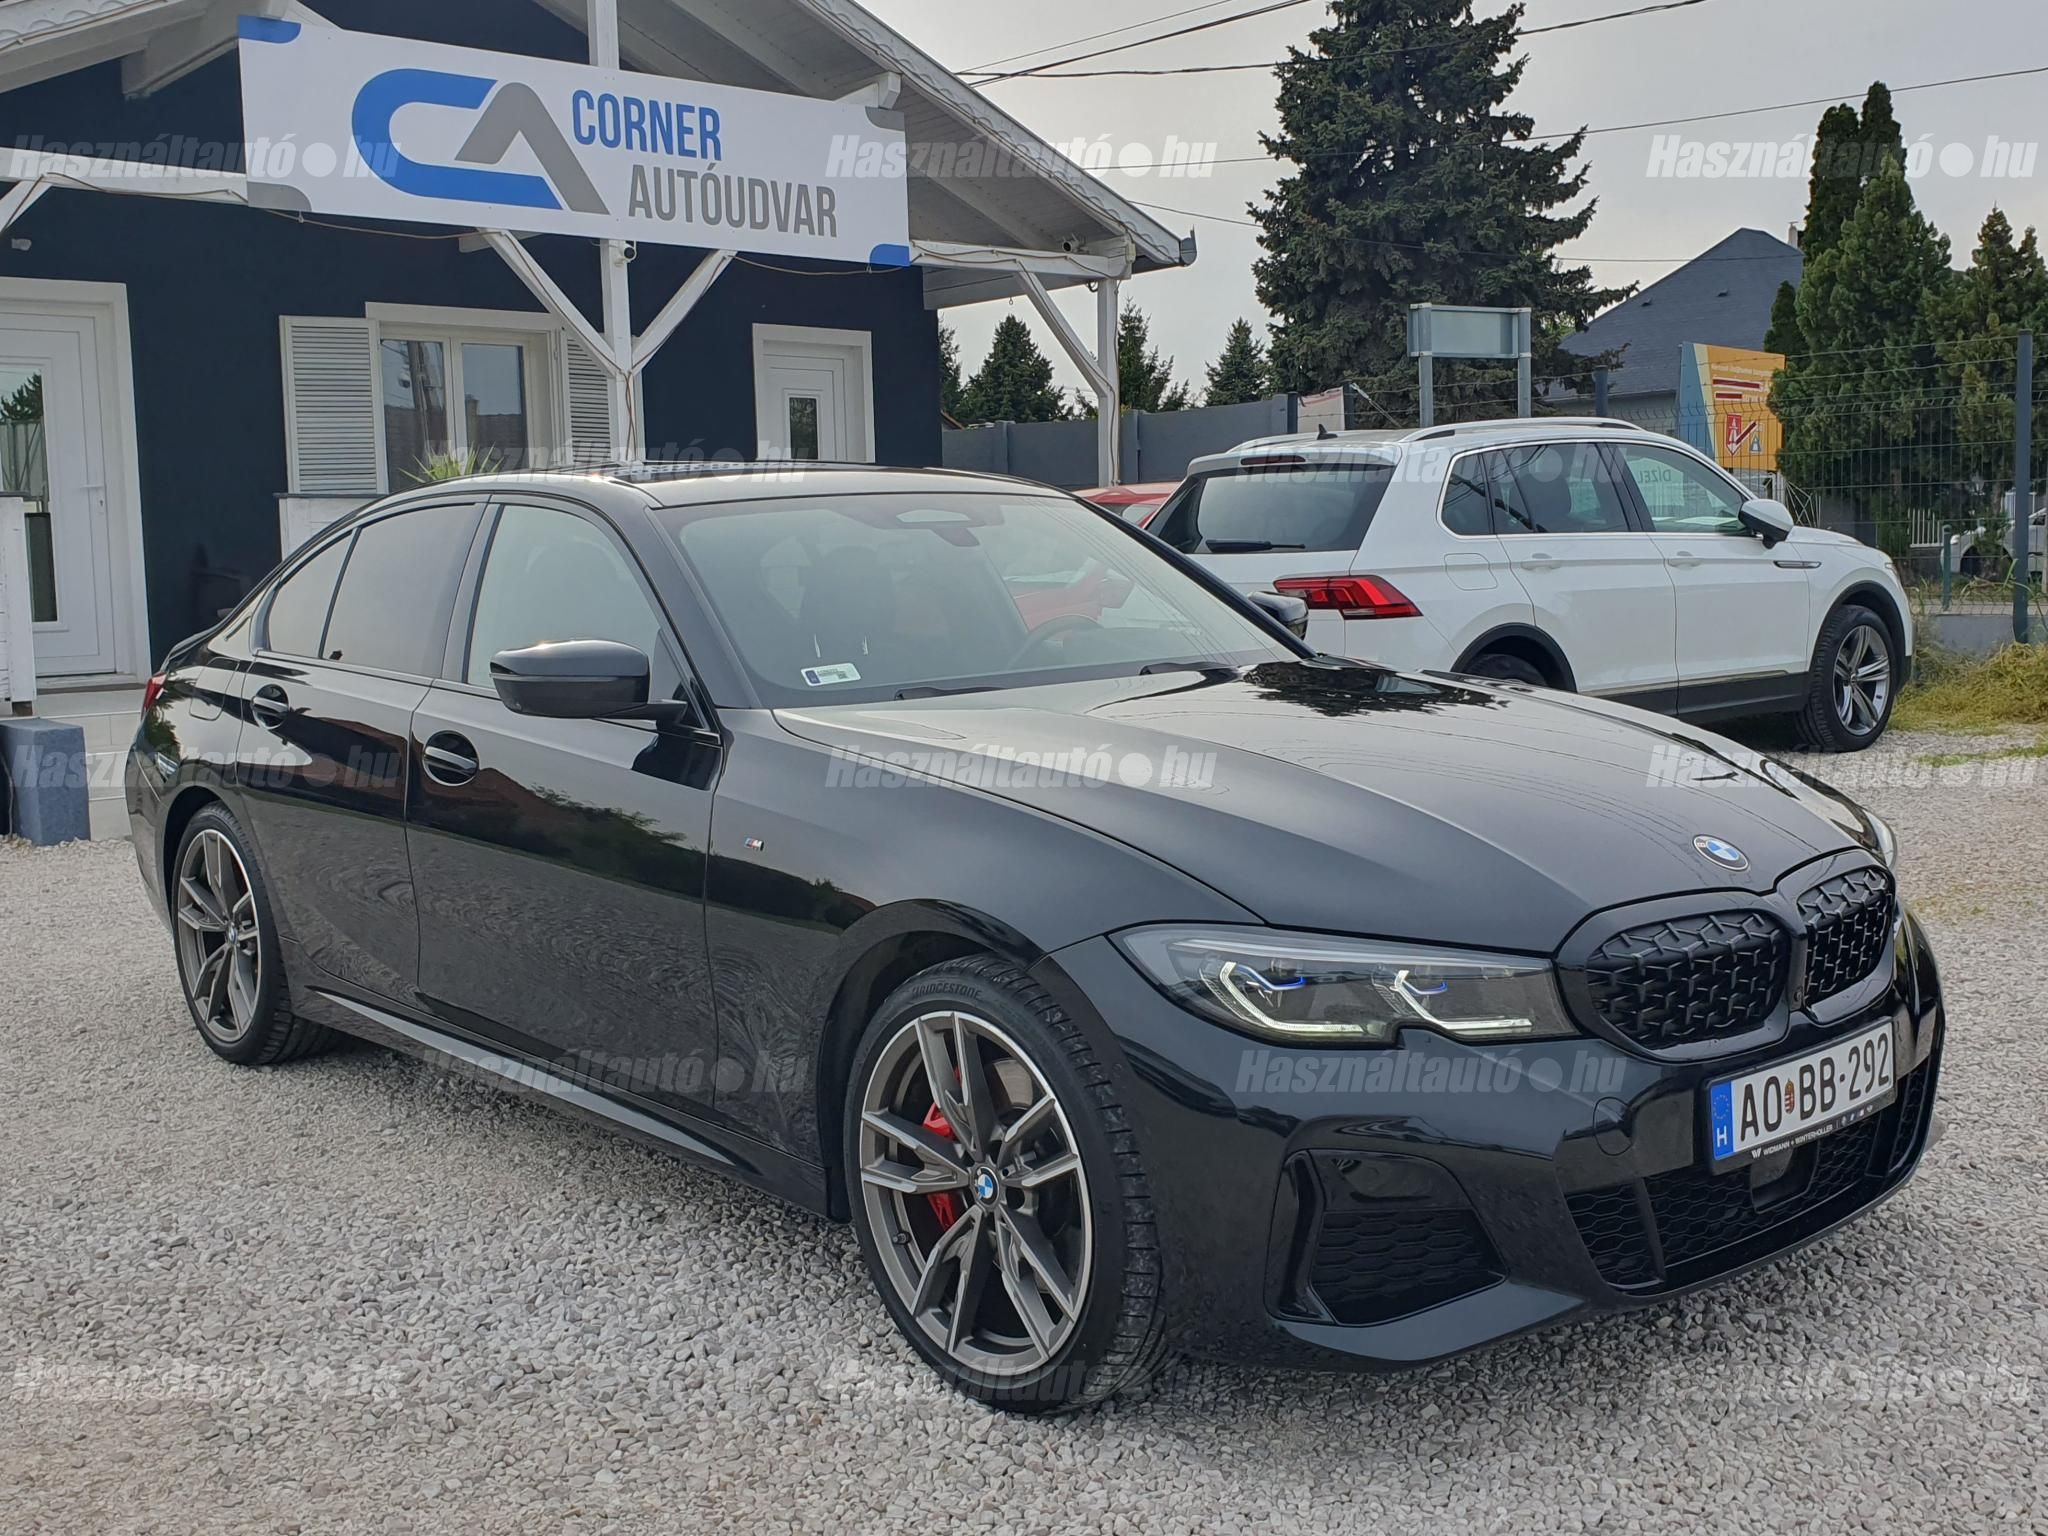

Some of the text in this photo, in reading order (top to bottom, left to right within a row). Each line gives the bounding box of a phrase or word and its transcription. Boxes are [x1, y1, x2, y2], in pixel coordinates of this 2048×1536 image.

[572, 89, 722, 161] CORNER
[628, 162, 837, 238] AUTÓUDVAR
[911, 982, 982, 1000] BRIDGESTONE
[1716, 1125, 1727, 1148] H
[1741, 1076, 1782, 1141] AO
